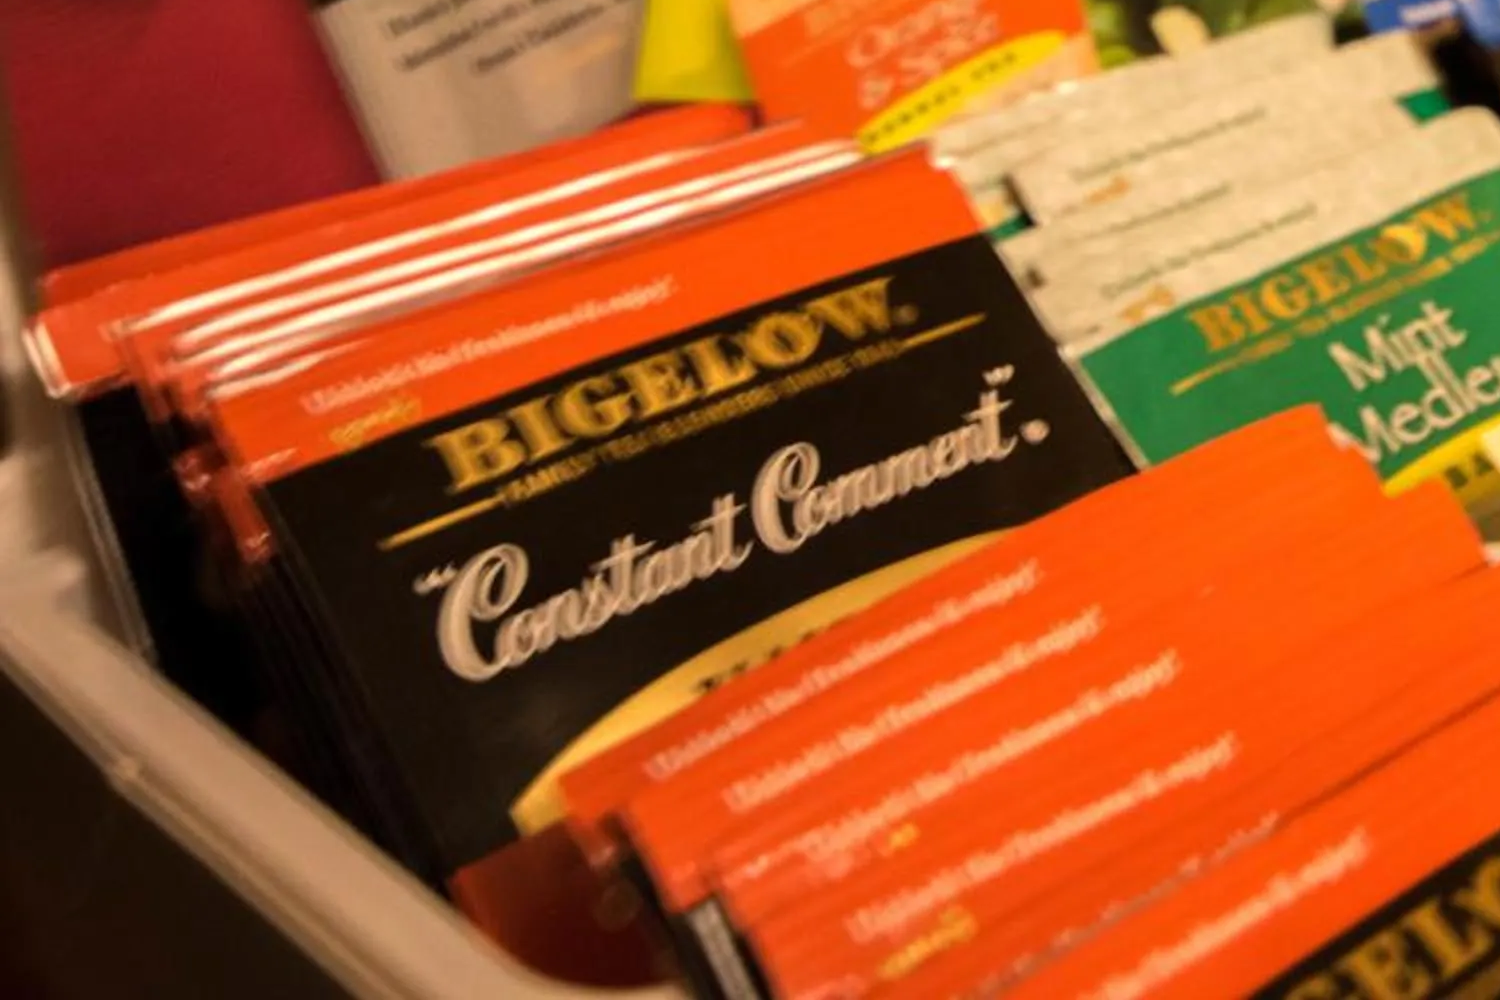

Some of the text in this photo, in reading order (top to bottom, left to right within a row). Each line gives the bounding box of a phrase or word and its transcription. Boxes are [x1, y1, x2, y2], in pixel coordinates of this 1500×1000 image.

[1189, 193, 1476, 352] BIGELOW
[1327, 300, 1468, 392] Mint
[425, 276, 898, 494] BIGELOW
